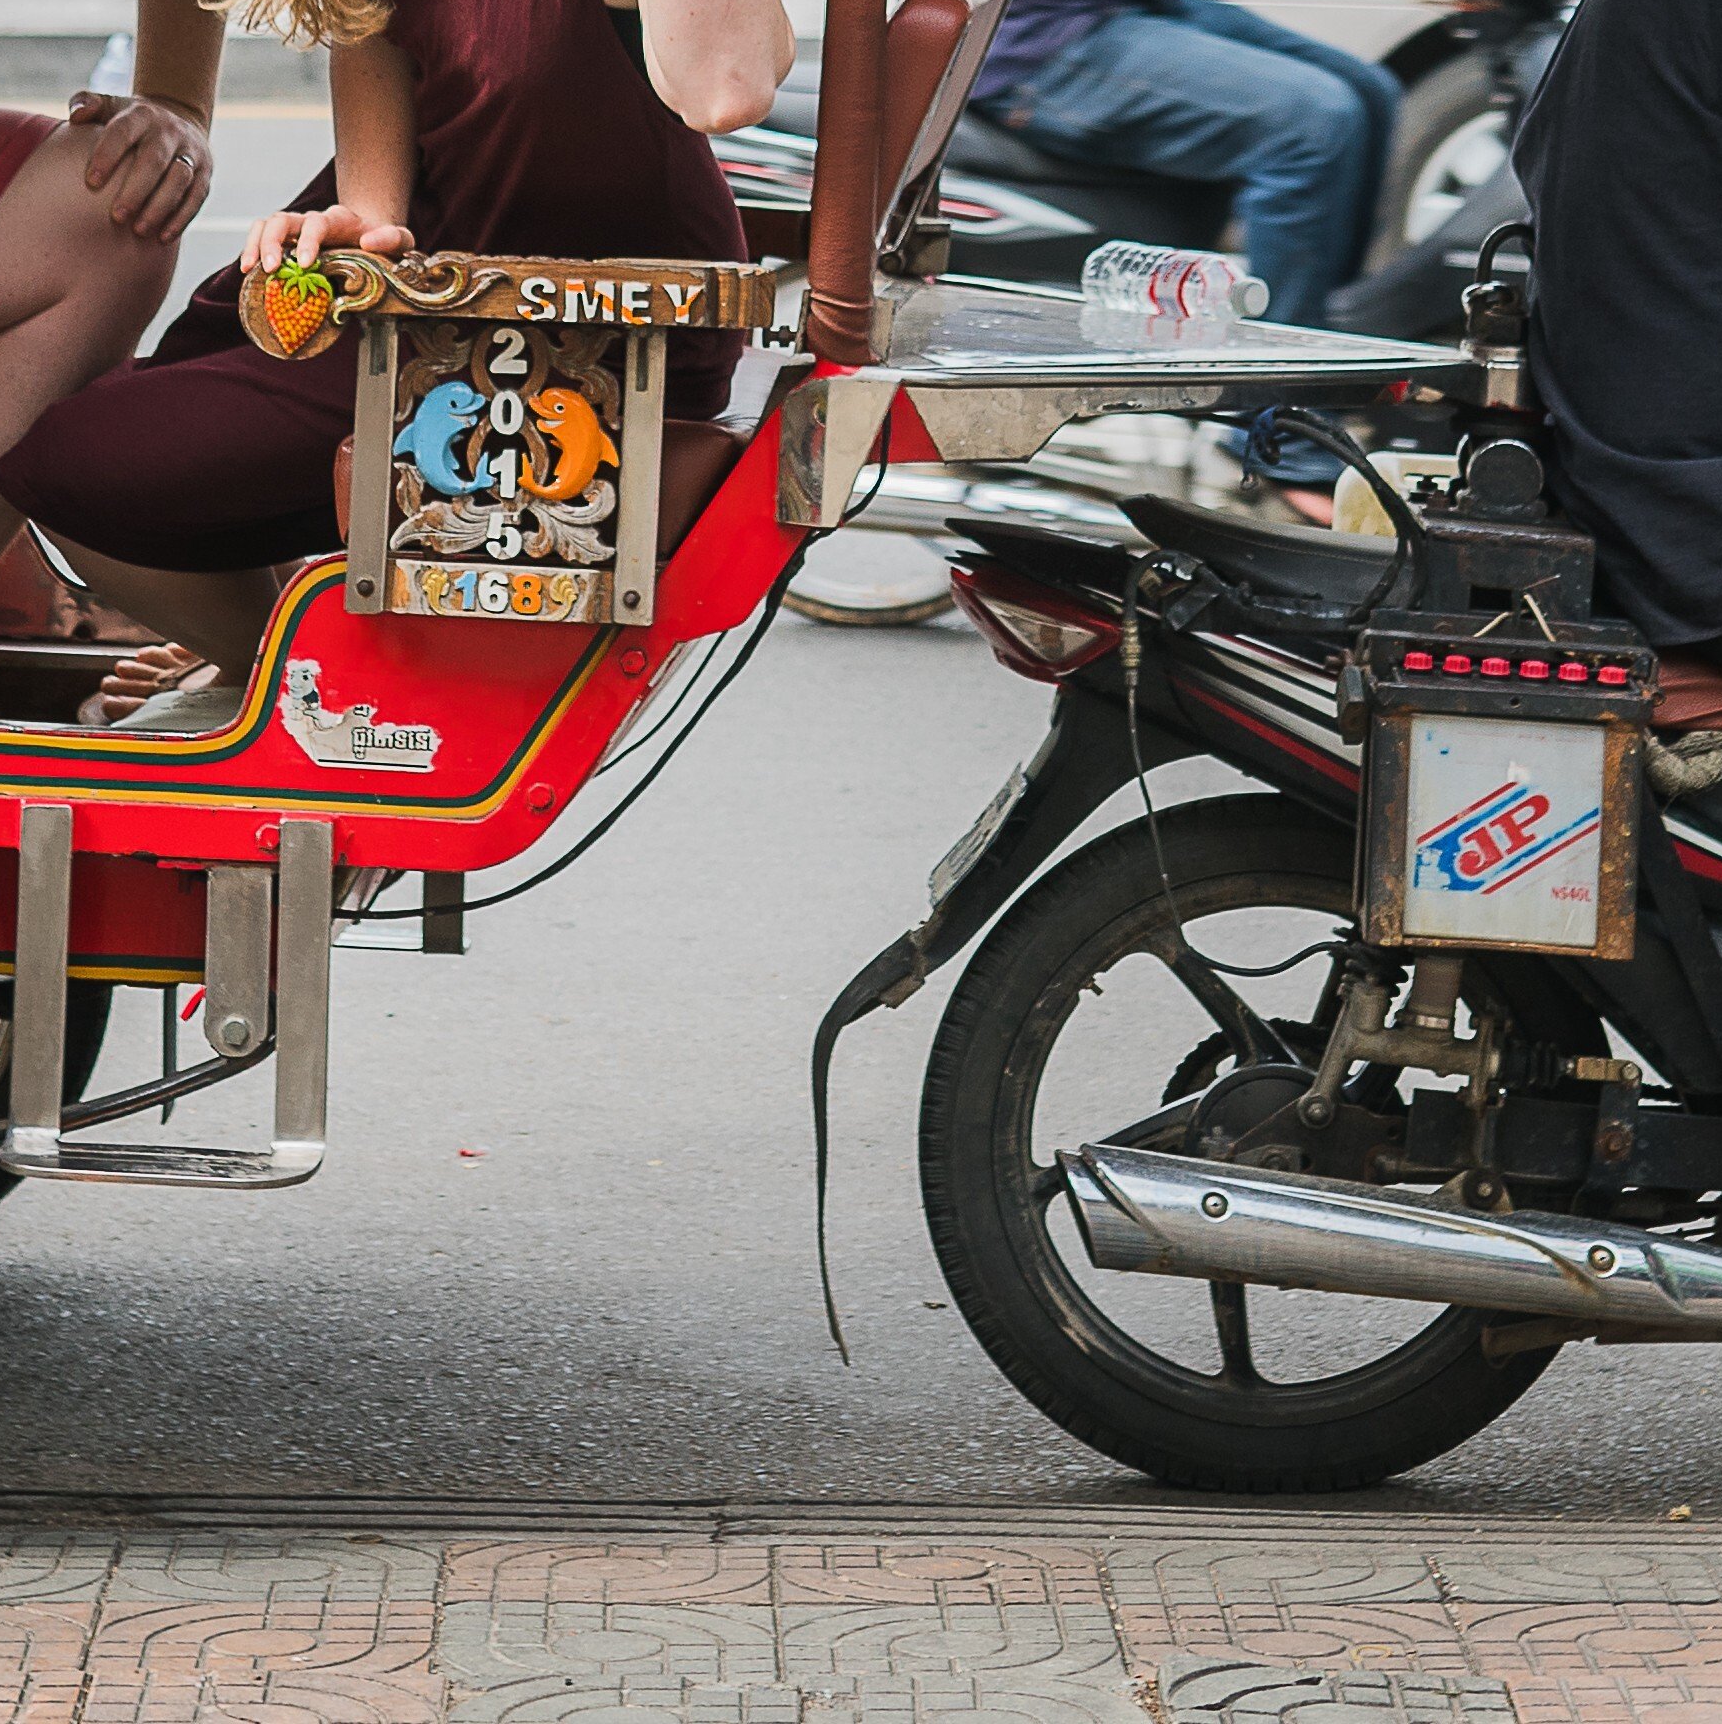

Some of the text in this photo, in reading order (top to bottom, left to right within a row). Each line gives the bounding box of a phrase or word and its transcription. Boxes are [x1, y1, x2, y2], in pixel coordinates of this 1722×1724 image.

[485, 328, 528, 561] 2015
[453, 570, 544, 616] 168
[1457, 793, 1551, 877] JP
